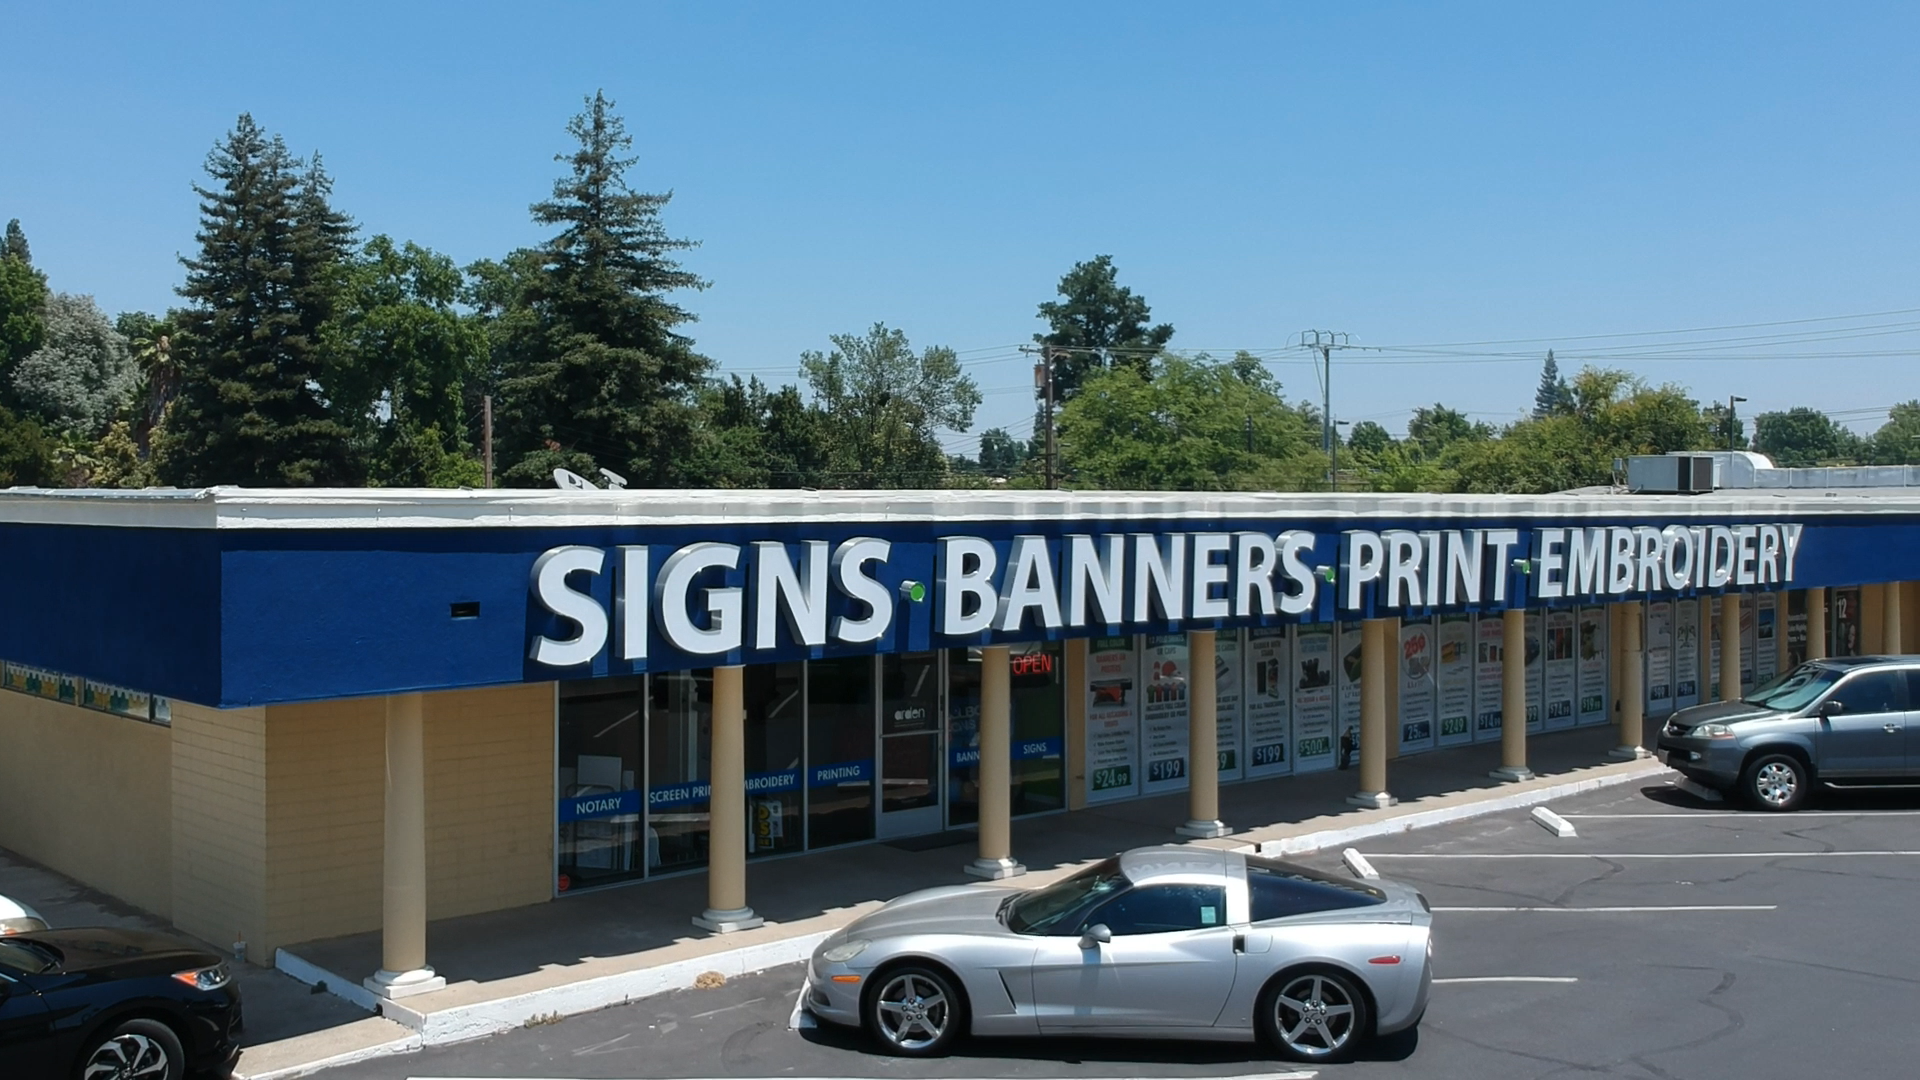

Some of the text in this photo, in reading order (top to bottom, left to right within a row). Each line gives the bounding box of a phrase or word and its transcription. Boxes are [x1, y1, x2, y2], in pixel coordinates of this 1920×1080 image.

[529, 523, 1803, 666] SIGNS BANNERS PRINT EMBROIDERY
[1013, 653, 1052, 675] OPEN
[894, 706, 926, 721] arden
[1444, 718, 1464, 733] $249
[1023, 742, 1047, 754] SIGNS
[1256, 745, 1281, 764] $199
[817, 765, 860, 781] PRINTING
[1096, 768, 1128, 787] $24.99
[1153, 760, 1180, 779] $199
[650, 787, 690, 804] SCREEN
[576, 797, 622, 815] NOTARY
